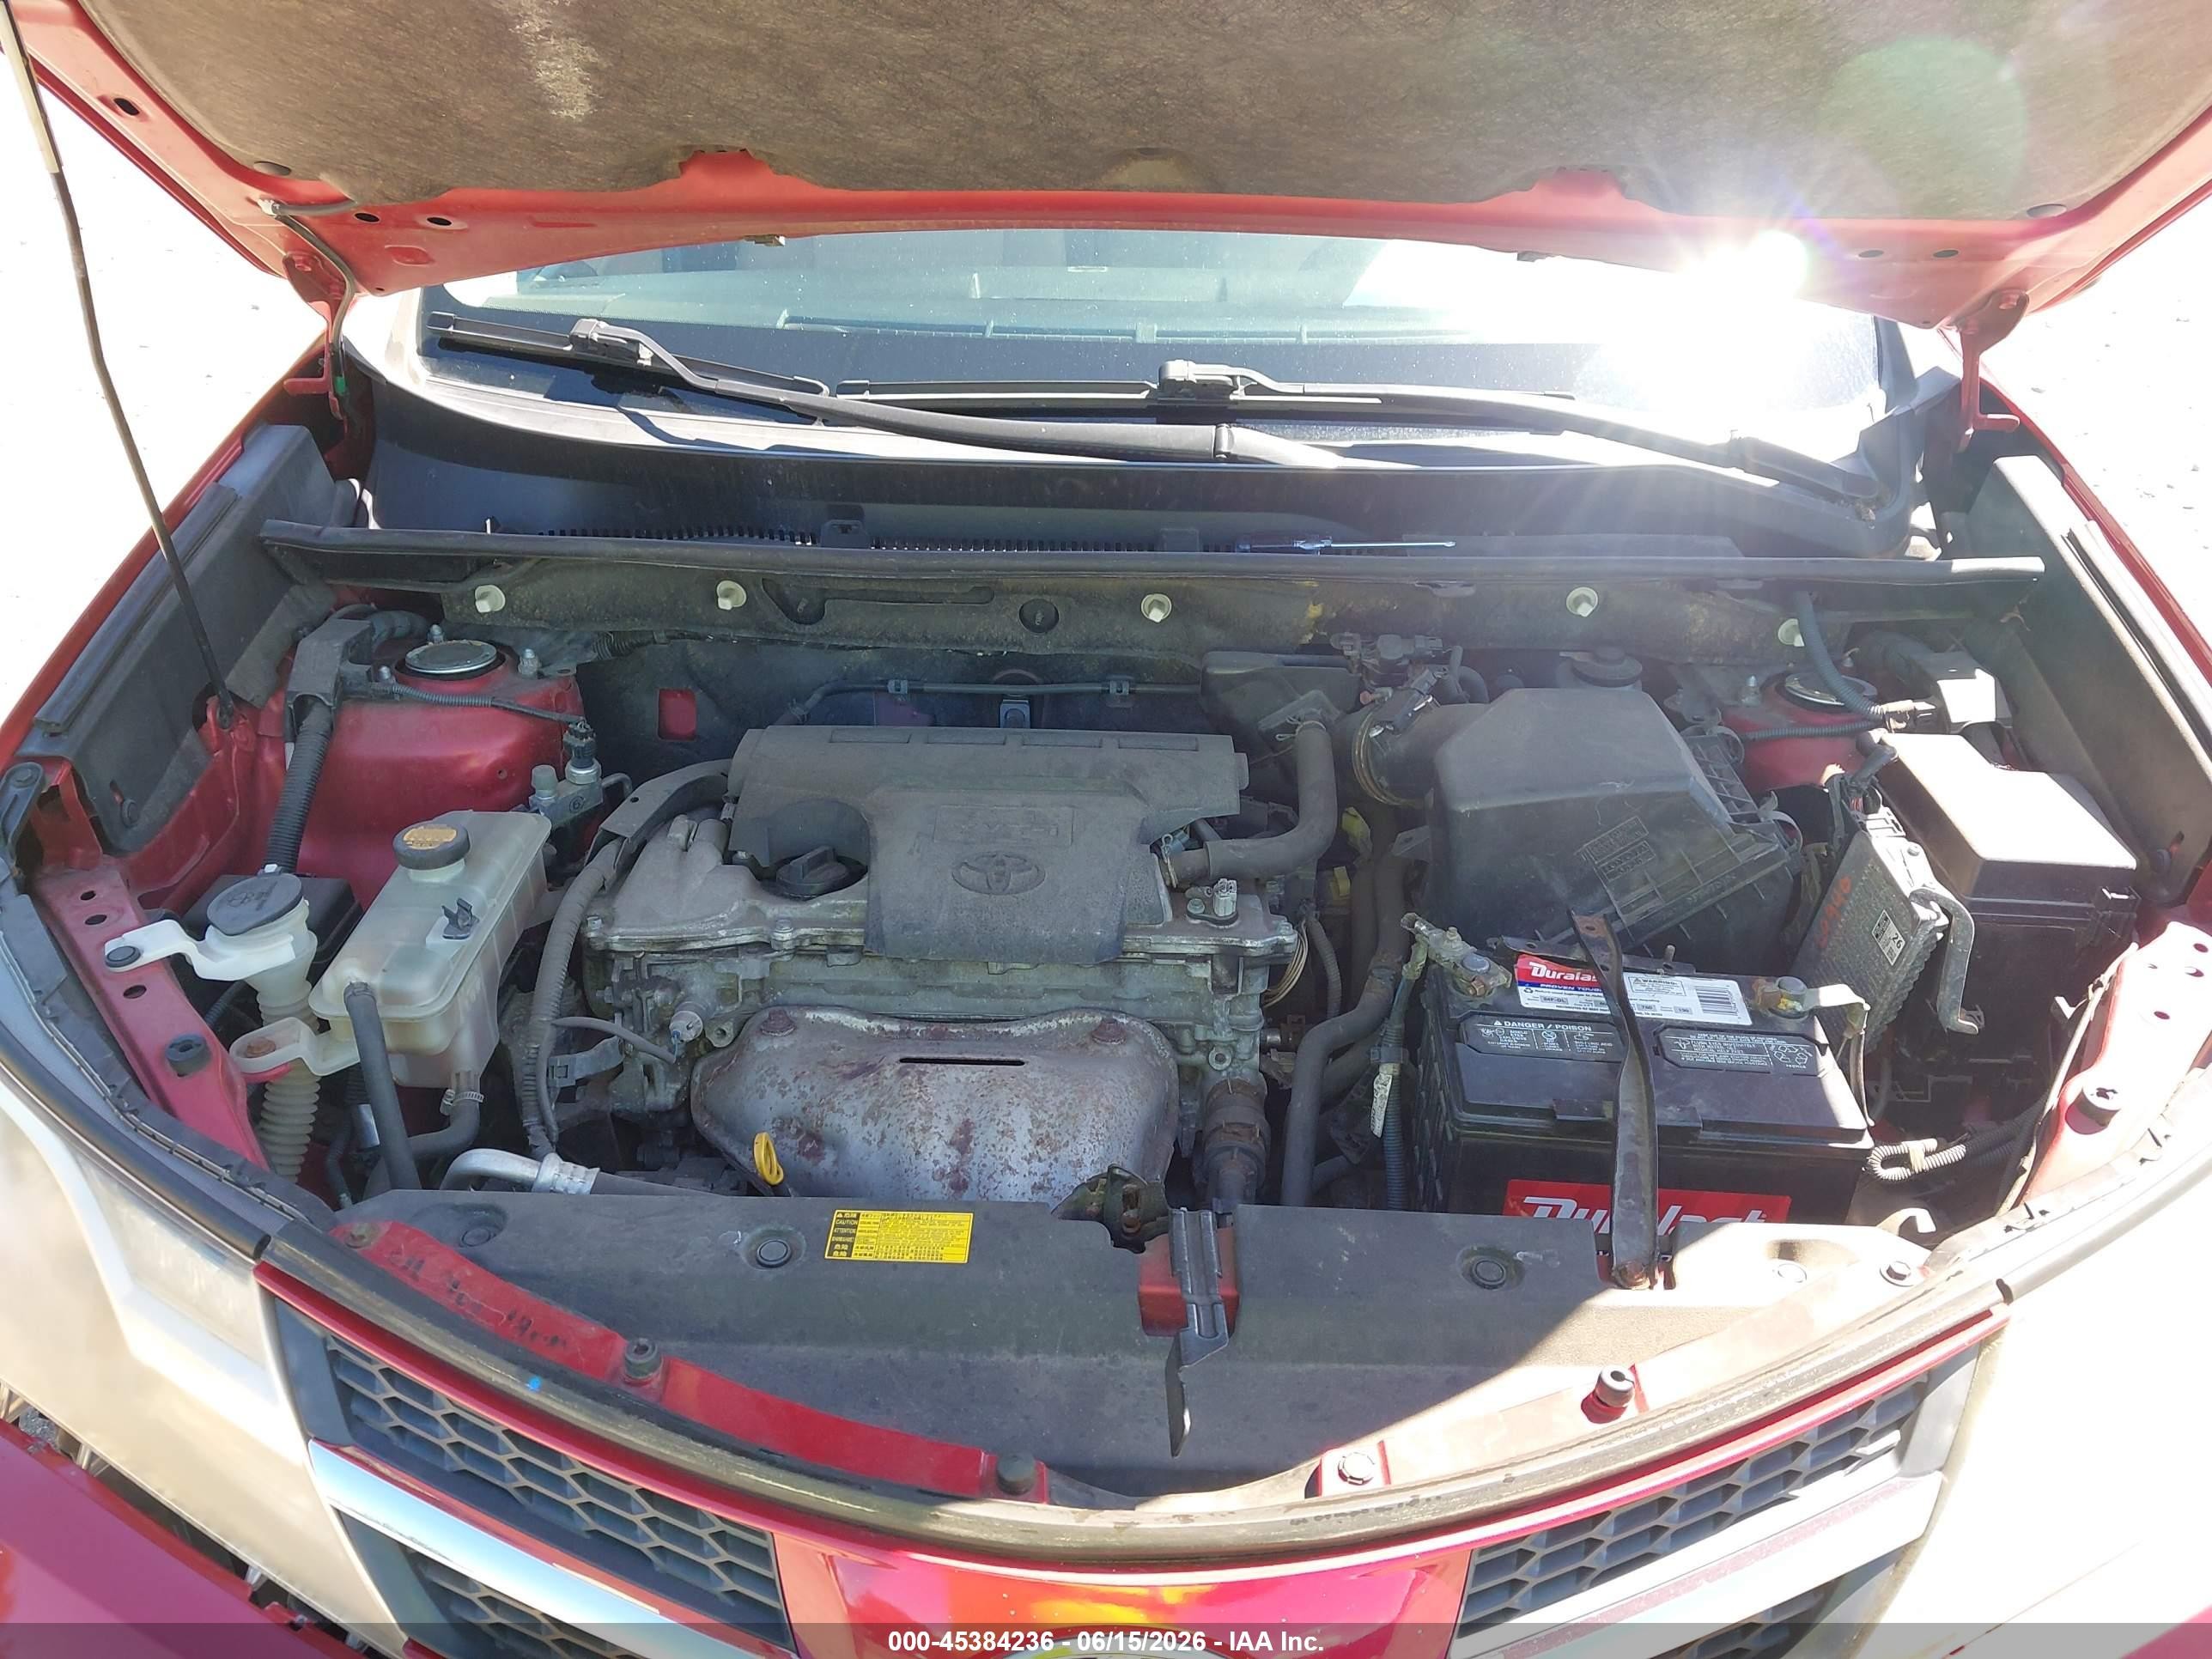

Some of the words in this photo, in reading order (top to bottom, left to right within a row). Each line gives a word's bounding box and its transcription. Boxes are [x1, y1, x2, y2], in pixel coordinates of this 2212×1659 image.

[1891, 933, 1904, 950] 26
[1529, 961, 1598, 982] Duralas
[1540, 982, 1575, 991] PROVEN
[1504, 1020, 1545, 1029] DANGER
